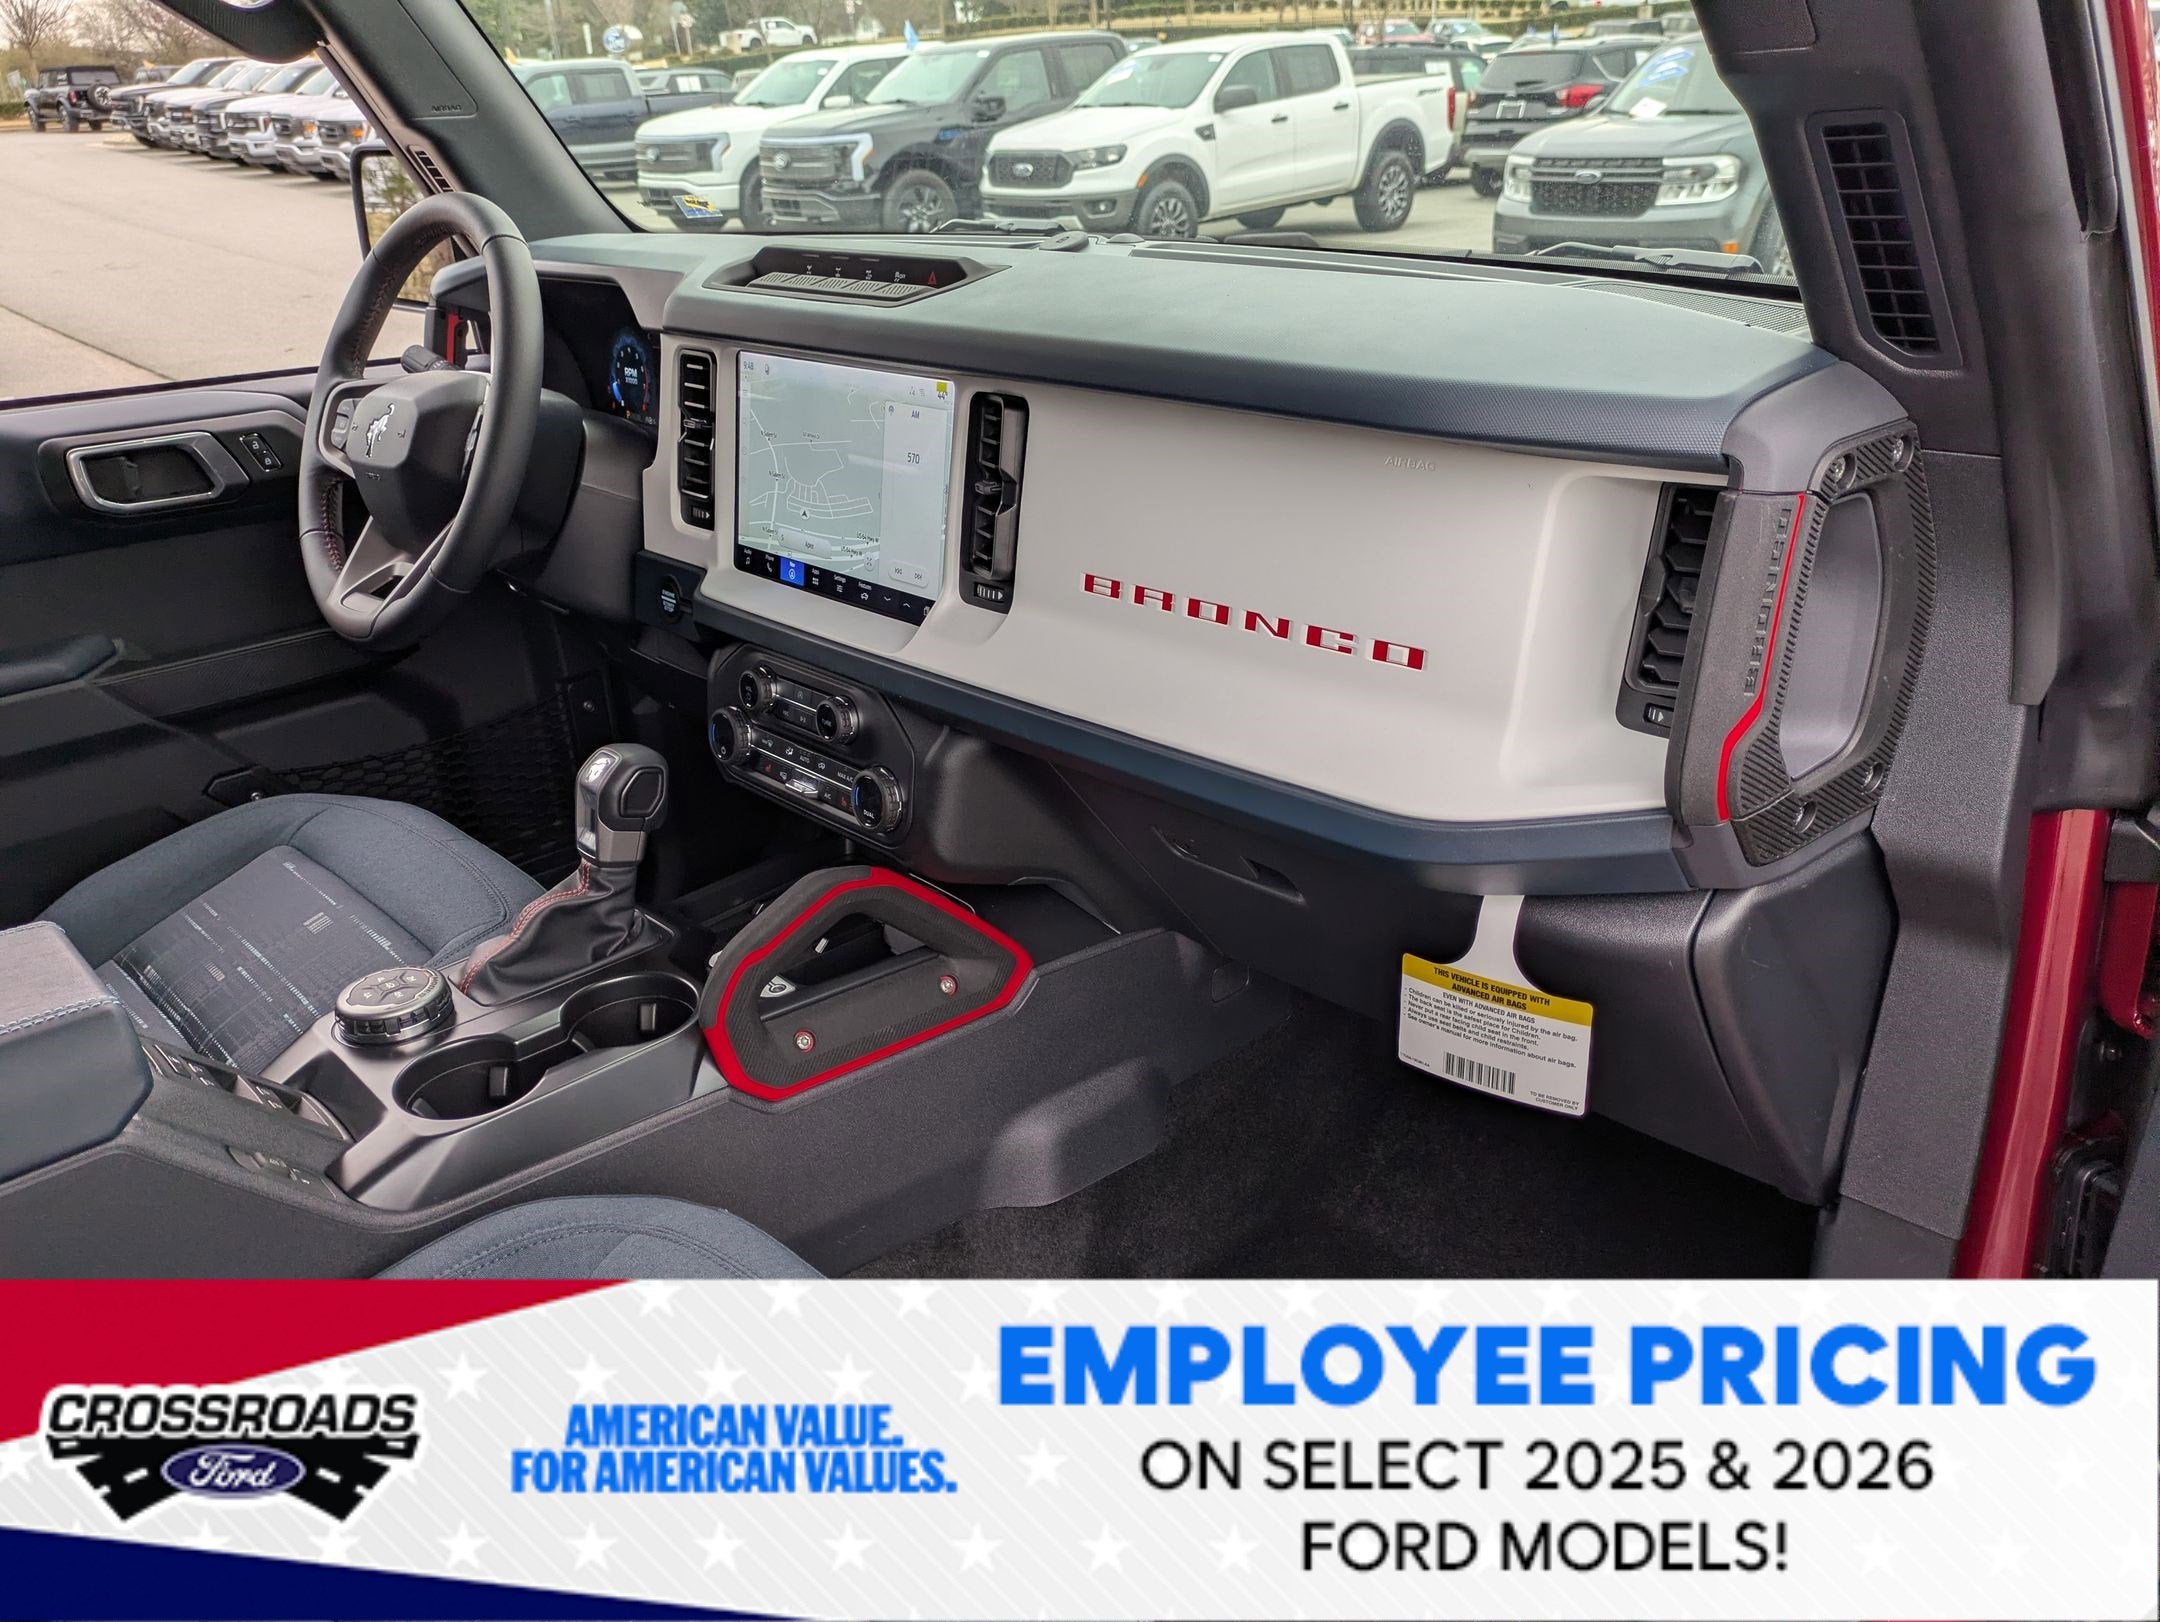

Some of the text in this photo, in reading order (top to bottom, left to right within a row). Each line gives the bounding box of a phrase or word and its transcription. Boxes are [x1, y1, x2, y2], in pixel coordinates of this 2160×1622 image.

[624, 366, 638, 378] RPM
[911, 410, 920, 419] AM
[907, 451, 920, 464] 570
[1384, 455, 1437, 472] AIRBAG
[1081, 573, 1428, 671] BRONCO
[1743, 508, 1792, 697] BRONCO
[1434, 967, 1550, 1006] THIS VEHICLE IS EQUIPPED WITH
[1452, 983, 1527, 1010] ADVANCED AIR BAGS
[1408, 1001, 1423, 1011] Never
[1425, 1007, 1434, 1015] put
[1452, 1016, 1470, 1028] facing
[1472, 1023, 1486, 1031] child
[1488, 1028, 1501, 1036] seat
[1521, 1037, 1539, 1046] front.
[1409, 988, 1431, 1000] Children
[1453, 1003, 1468, 1012] killed
[1477, 1012, 1505, 1024] seriously
[1507, 1020, 1529, 1030] injured
[1563, 1033, 1578, 1041] bag.
[1420, 998, 1432, 1007] back
[1434, 1004, 1445, 1012] seat
[1453, 1010, 1462, 1018] the
[1464, 1014, 1481, 1023] safest
[1483, 1020, 1500, 1029] place
[1512, 1027, 1540, 1039] Children.
[1443, 992, 1535, 1024] EVEN WITH ADVANCED AIR BAGS
[1408, 1007, 1426, 1018] Always
[1453, 1023, 1466, 1032] belts
[1468, 1029, 1479, 1037] and
[1481, 1032, 1496, 1041] child
[1497, 1037, 1529, 1050] restraints.
[1408, 1013, 1417, 1021] See
[1418, 1019, 1439, 1029] owner's
[1441, 1027, 1462, 1037] manual
[1473, 1037, 1488, 1046] more
[1490, 1042, 1526, 1056] information
[1527, 1052, 1546, 1061] about
[1547, 1055, 1556, 1063] air
[1558, 1059, 1577, 1068] bags.
